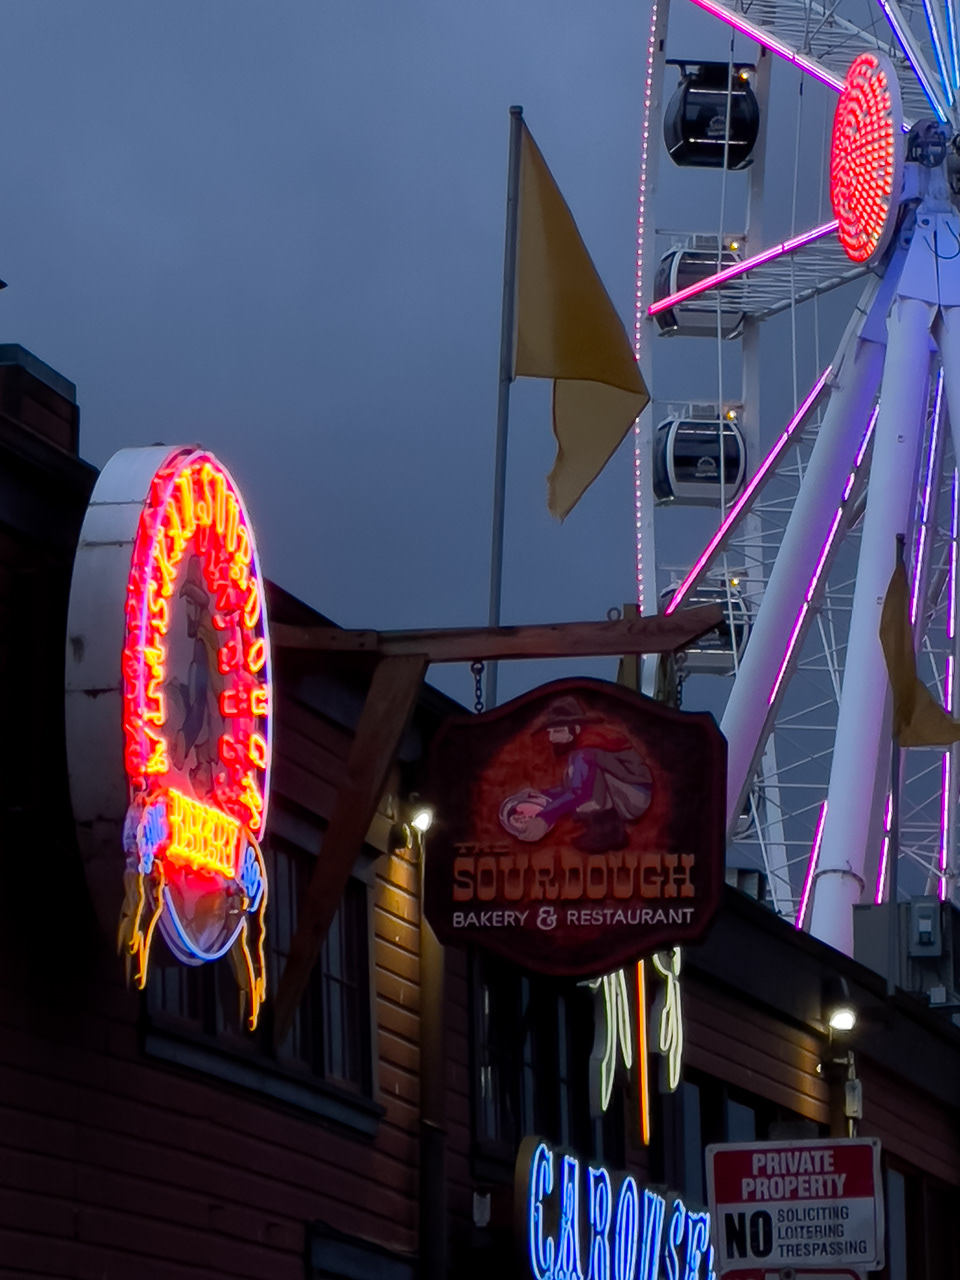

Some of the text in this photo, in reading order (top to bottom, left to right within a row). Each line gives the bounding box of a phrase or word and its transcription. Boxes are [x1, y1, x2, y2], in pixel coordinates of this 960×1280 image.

[452, 853, 696, 901] SOURDOUGH
[453, 906, 695, 930] BAKERY & RESTAURANT
[752, 1150, 835, 1176] PRIVATE
[741, 1173, 847, 1200] PROPERTY
[777, 1205, 849, 1223] SOLICITING
[724, 1210, 773, 1260] NO
[777, 1223, 845, 1241] LOITERING
[778, 1239, 868, 1258] TRESPASSING
